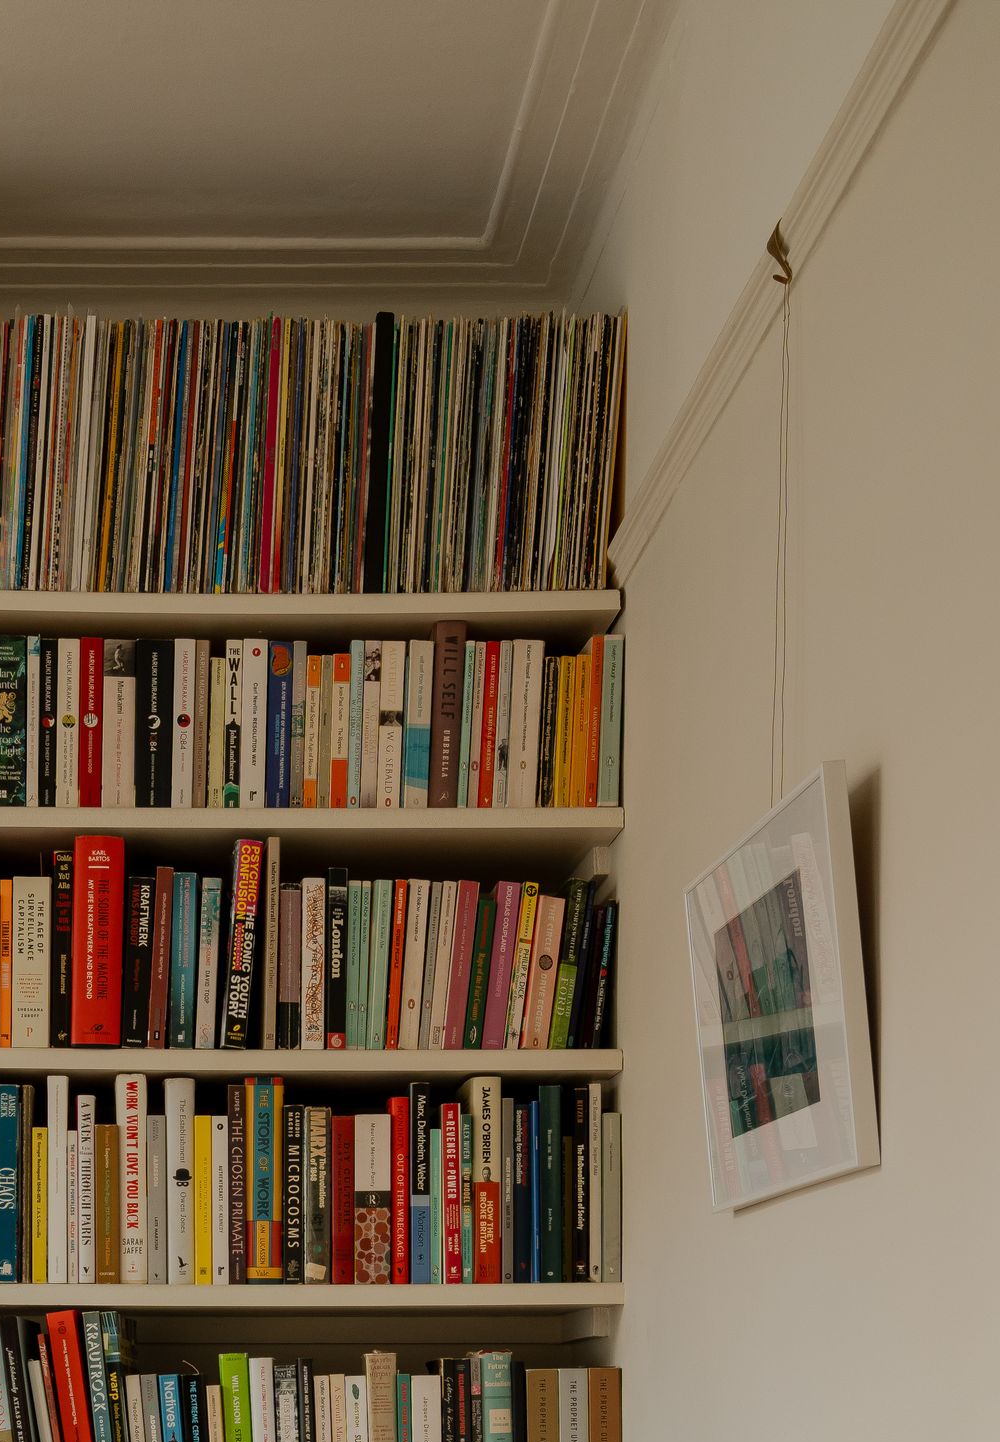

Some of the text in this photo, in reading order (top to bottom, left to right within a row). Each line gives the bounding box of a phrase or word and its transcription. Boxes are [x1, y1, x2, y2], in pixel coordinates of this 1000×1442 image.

[228, 658, 240, 714] WALL
[441, 636, 458, 720] WILL SELF
[228, 746, 236, 781] Lanchester
[441, 730, 450, 778] UMBRELLA
[87, 880, 94, 890] MY
[236, 844, 250, 920] CONFUSION
[248, 845, 260, 902] PSYCHIC
[27, 893, 35, 961] SURVEILLANCE
[96, 880, 110, 1000] THE SOUND OF THE MACHINE
[137, 885, 150, 947] KRAFTWERK
[245, 905, 257, 929] THE
[499, 886, 512, 953] DOUGLAS COUPLAND
[37, 943, 44, 954] OF
[241, 932, 255, 973] SONIC
[331, 919, 343, 979] London
[228, 975, 240, 1018] STORY
[238, 976, 250, 1019] YOUTH
[126, 1081, 138, 1229] WORK WON'T LOVE YOU BACK
[310, 1111, 326, 1159] MARX
[81, 1159, 91, 1246] THROUGH PARIS
[231, 1117, 243, 1255] THE CHOSEN PRIMATE
[287, 1145, 300, 1248] MICROCOSMS
[397, 1174, 404, 1186] OF
[87, 1322, 108, 1412] KRAUTROCK
[109, 1372, 119, 1401] warp
[189, 1380, 197, 1393] THE
[539, 1379, 547, 1393] THE
[600, 1378, 608, 1391] THE
[164, 1381, 176, 1428] Natives
[190, 1394, 199, 1423] EXTREME
[231, 1375, 241, 1424] WILL ASHON
[539, 1396, 547, 1433] PROPHET
[600, 1394, 608, 1429] PROPHET
